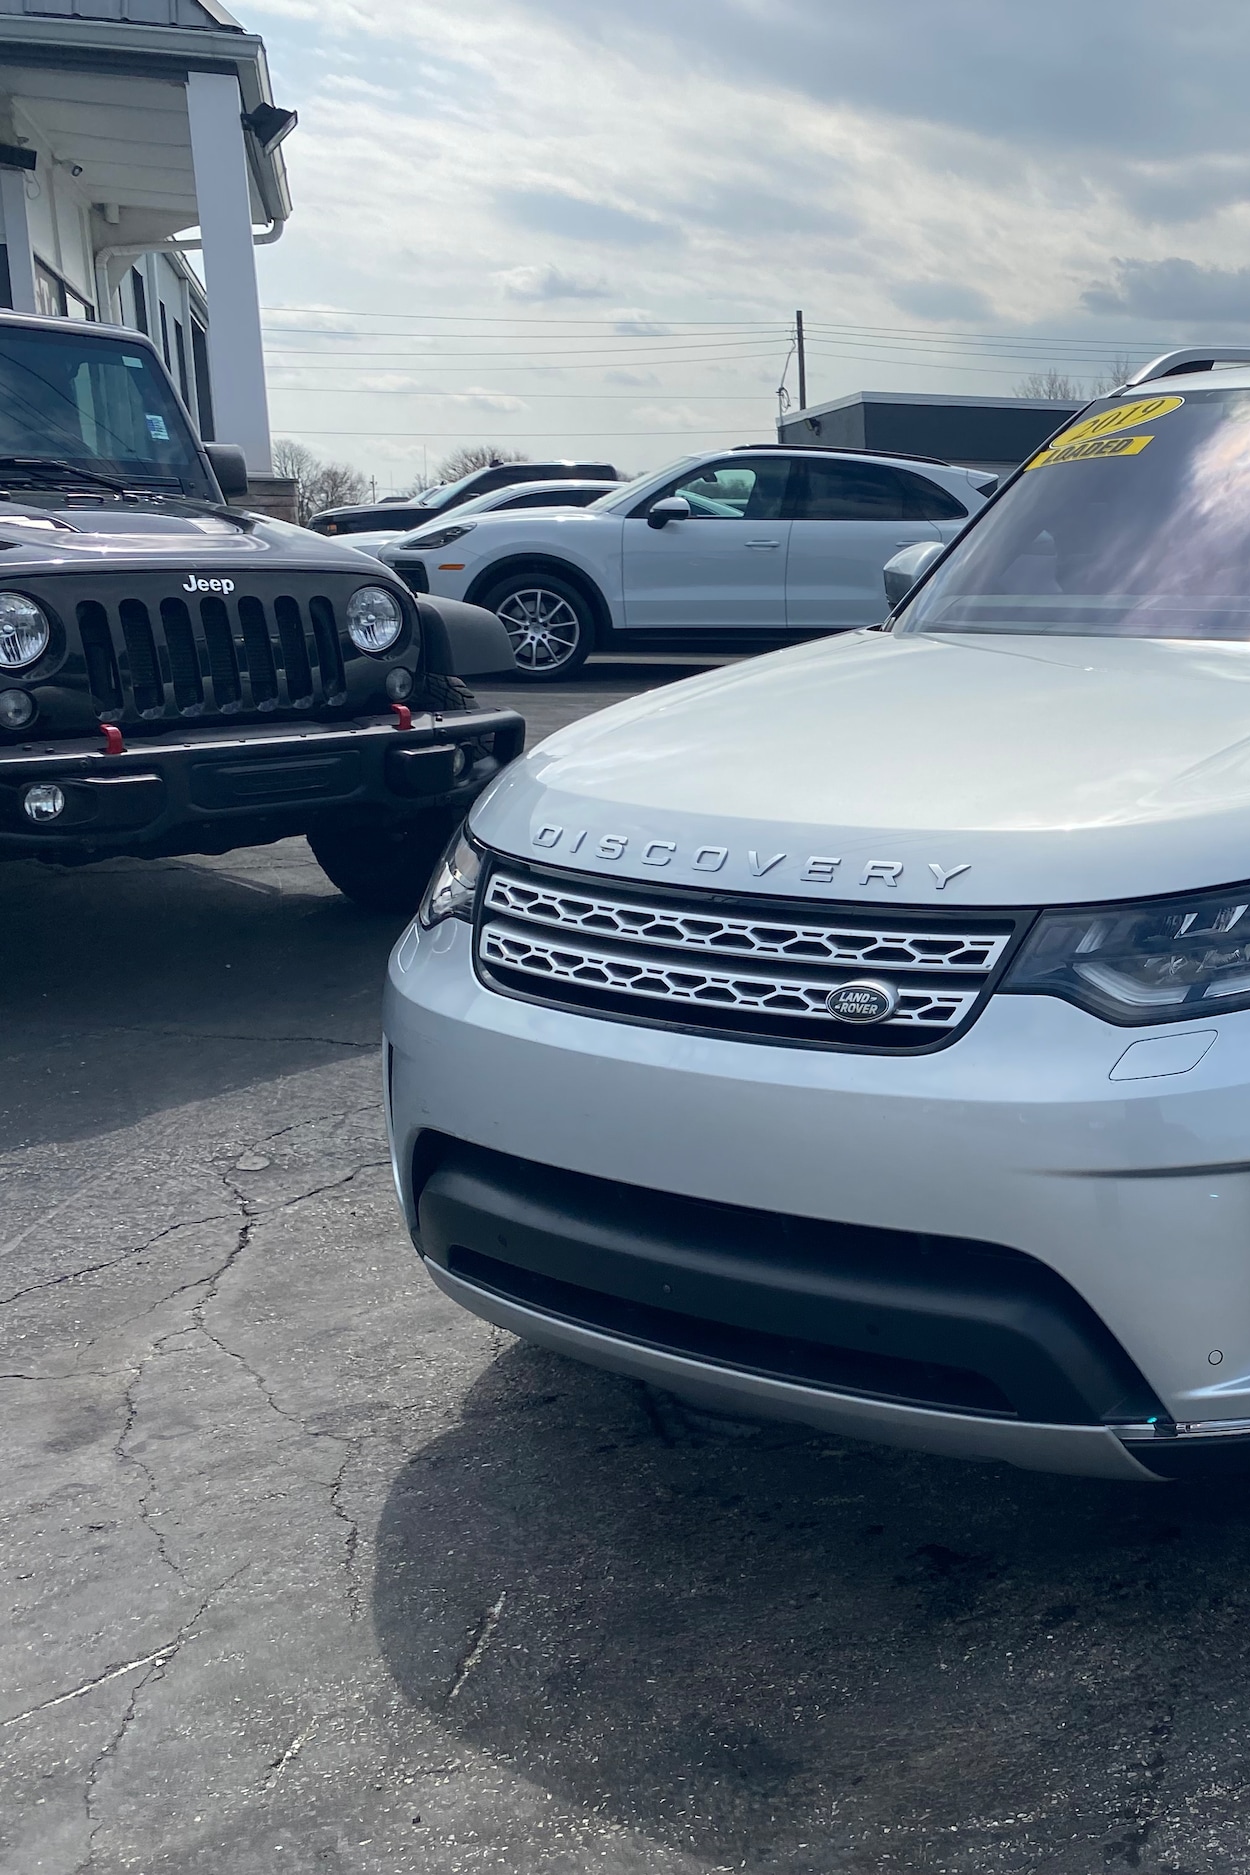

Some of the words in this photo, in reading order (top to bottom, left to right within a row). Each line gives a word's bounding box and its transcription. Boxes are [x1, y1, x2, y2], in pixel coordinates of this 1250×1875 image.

[1066, 399, 1166, 443] 2019
[1040, 438, 1134, 466] LOADED
[182, 574, 235, 595] Jeep
[532, 822, 972, 890] DISCOVERY
[839, 991, 871, 1003] LAND
[840, 1002, 879, 1015] ROVER
